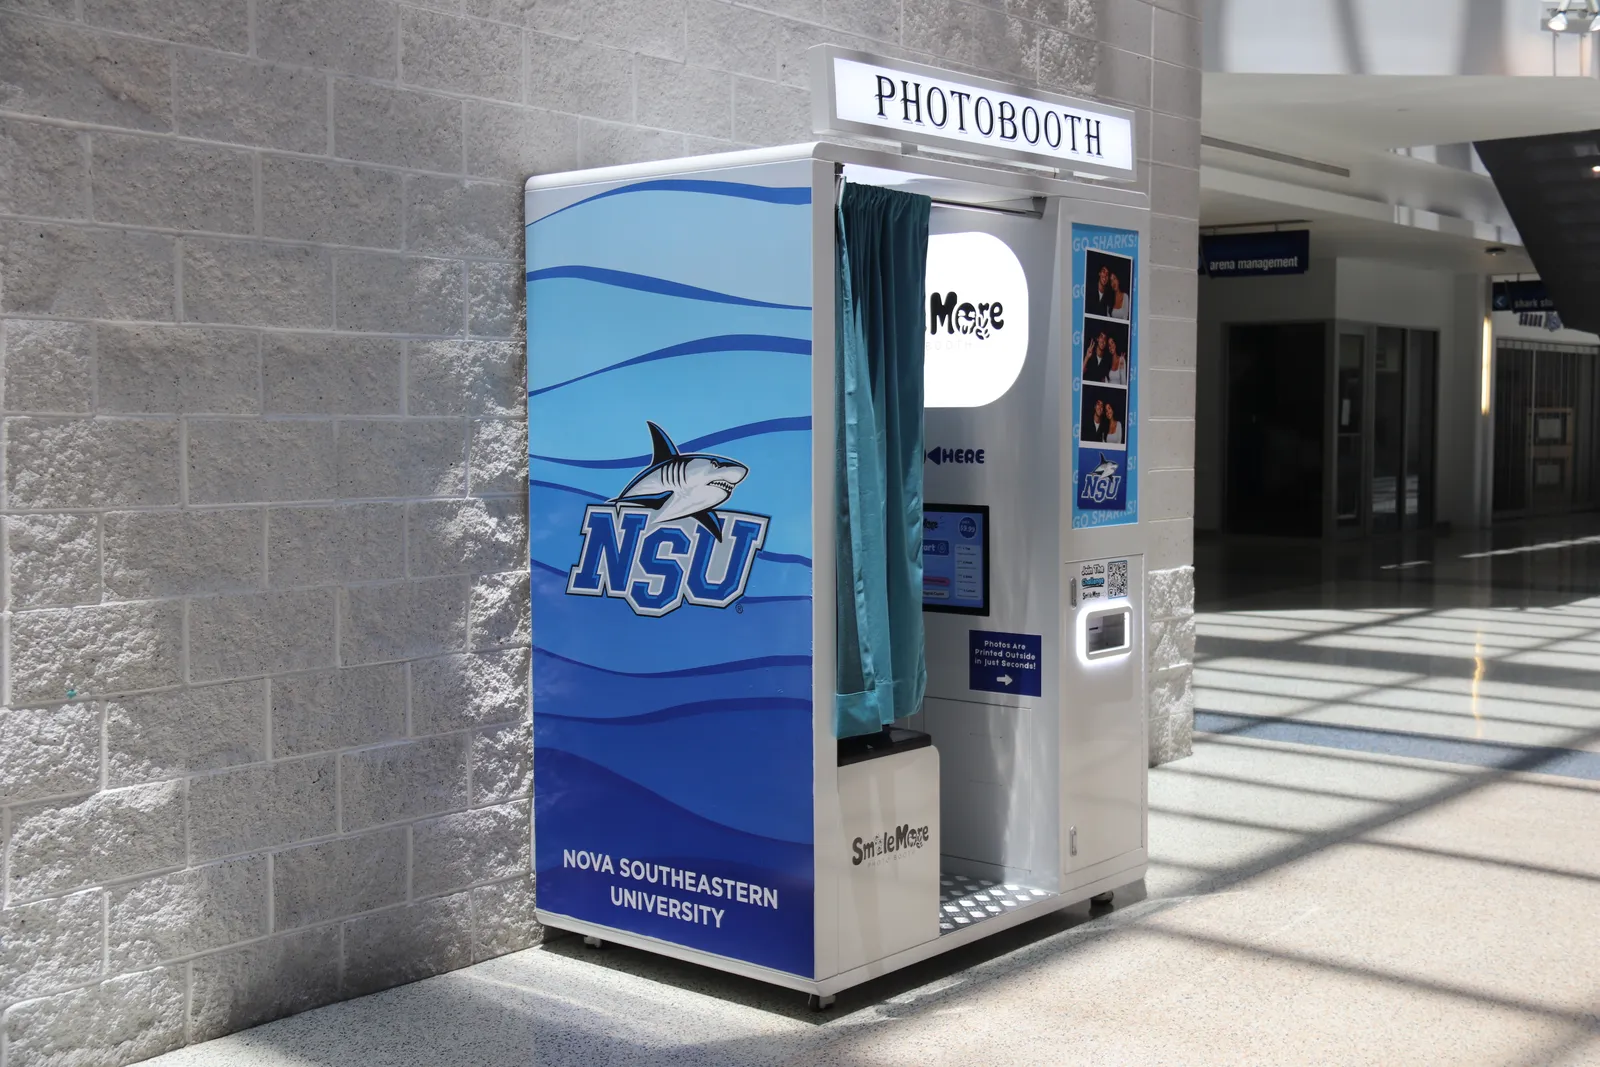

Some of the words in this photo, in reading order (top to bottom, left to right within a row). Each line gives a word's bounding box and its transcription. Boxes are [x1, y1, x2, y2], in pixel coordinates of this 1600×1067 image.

[874, 74, 1104, 158] PHOTOBOOTH
[1072, 237, 1089, 252] GO
[1092, 234, 1137, 250] SHARKS!
[1209, 260, 1235, 271] arena
[1237, 255, 1299, 271] management
[942, 448, 985, 464] HERE
[1081, 474, 1122, 503] NSU
[1072, 513, 1089, 528] GO
[565, 503, 772, 618] NSU
[984, 640, 1011, 649] Photos
[1012, 643, 1026, 651] Are
[974, 648, 1003, 658] Printed
[1005, 651, 1036, 661] Outside
[974, 657, 982, 665] in
[1001, 659, 1037, 670] Seconds!
[563, 848, 615, 876] NOVA
[619, 857, 779, 910] SOUTHEASTERN
[610, 885, 725, 929] UNIVERSITY
